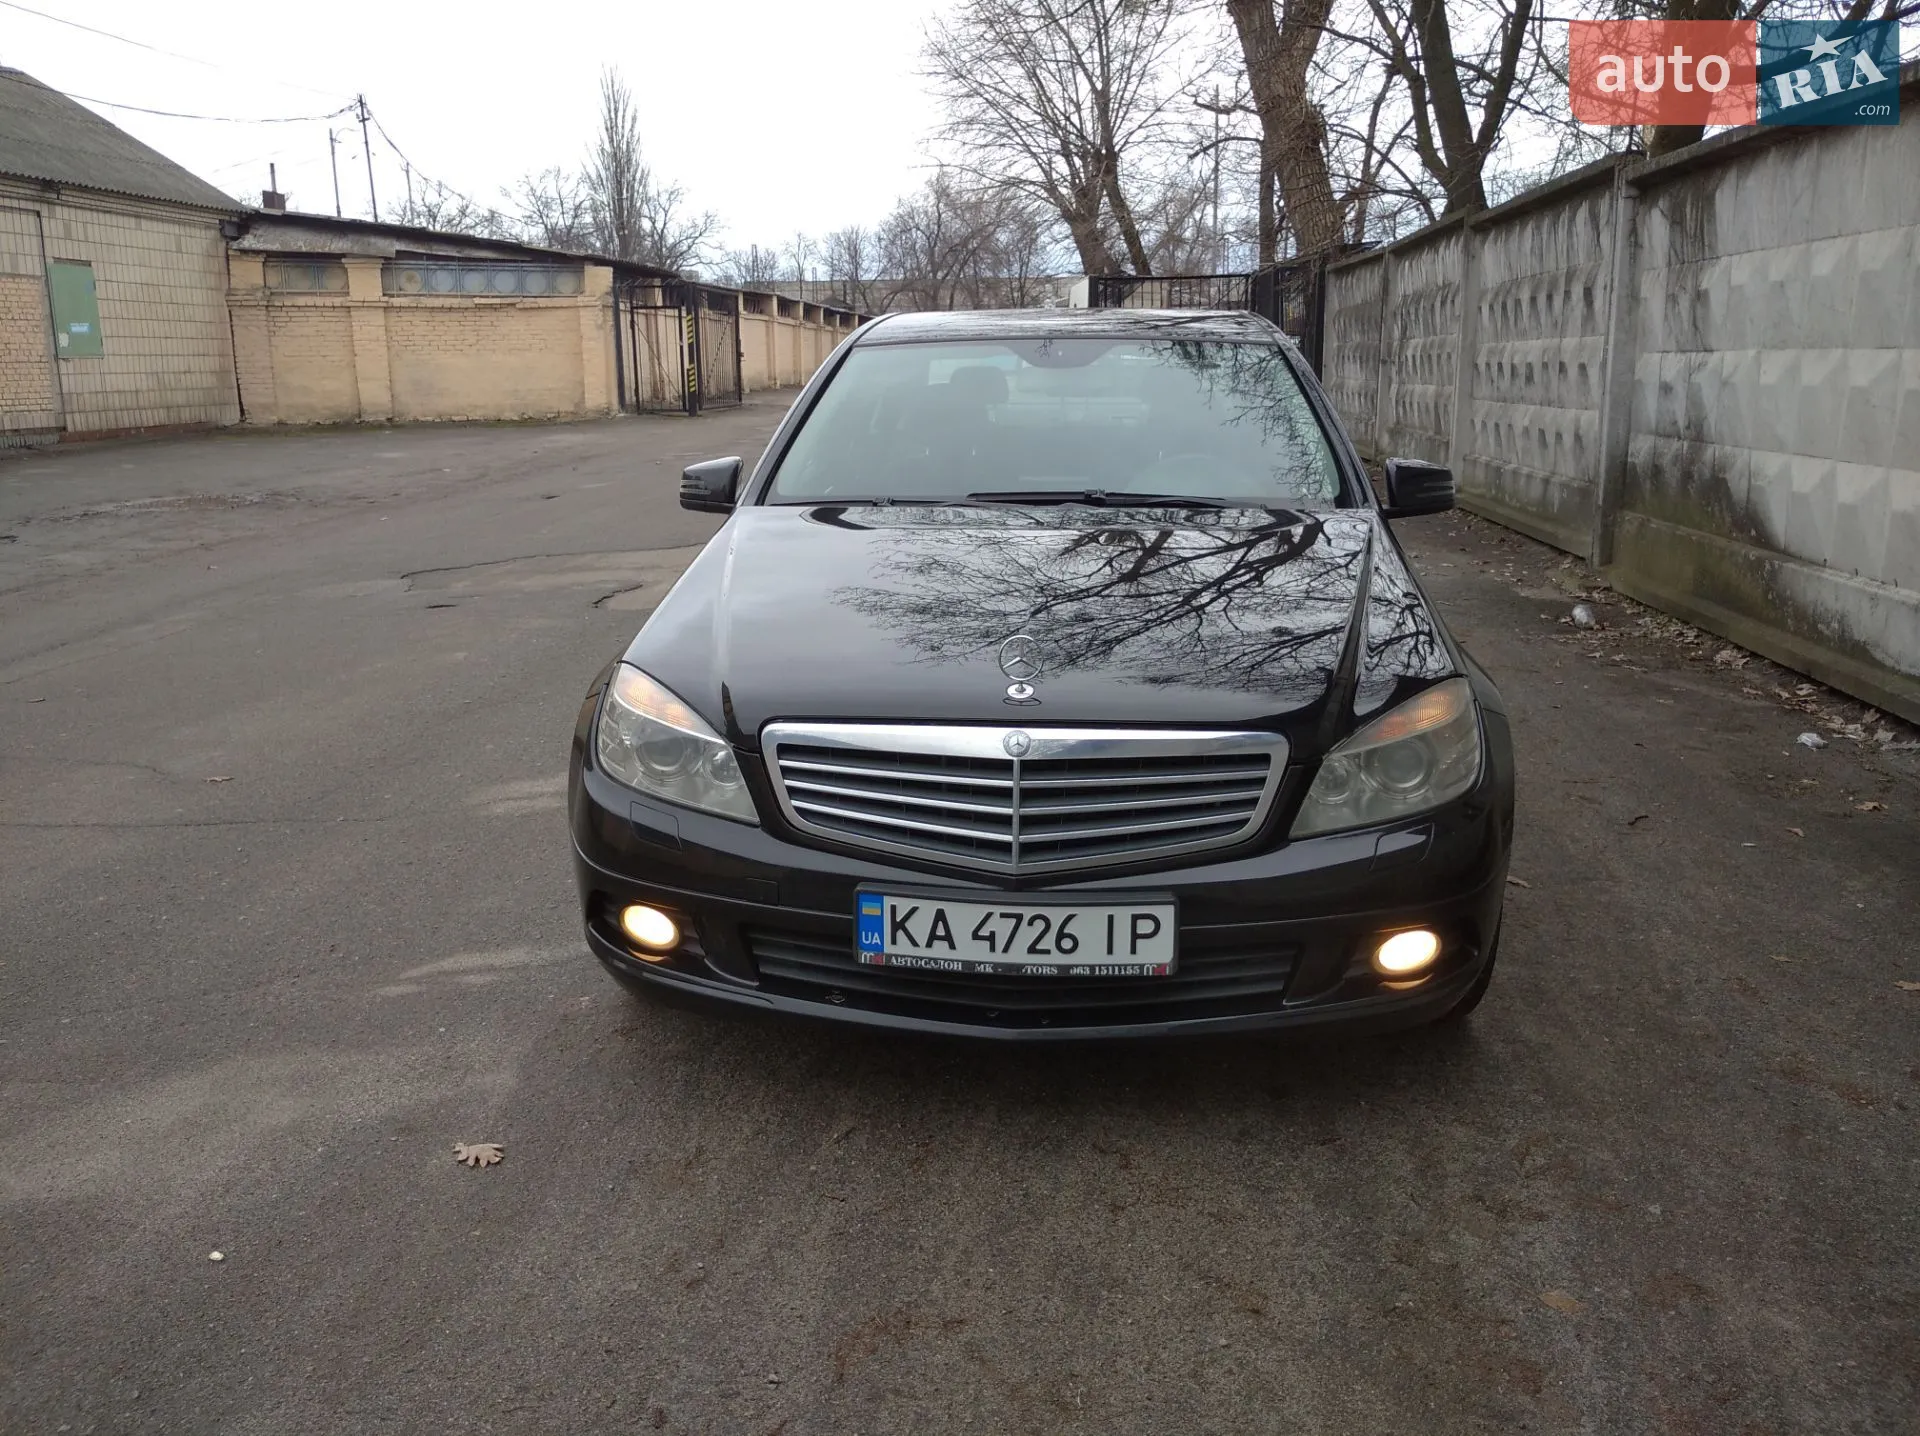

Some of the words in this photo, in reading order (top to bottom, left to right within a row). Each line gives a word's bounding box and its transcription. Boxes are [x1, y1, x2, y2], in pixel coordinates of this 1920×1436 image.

[862, 931, 881, 945] UA
[890, 904, 957, 950] KA
[971, 911, 1079, 955] 4726
[1107, 913, 1161, 955] IP
[890, 956, 962, 970] АВТОСАЛОН
[1022, 965, 1058, 975] TORS
